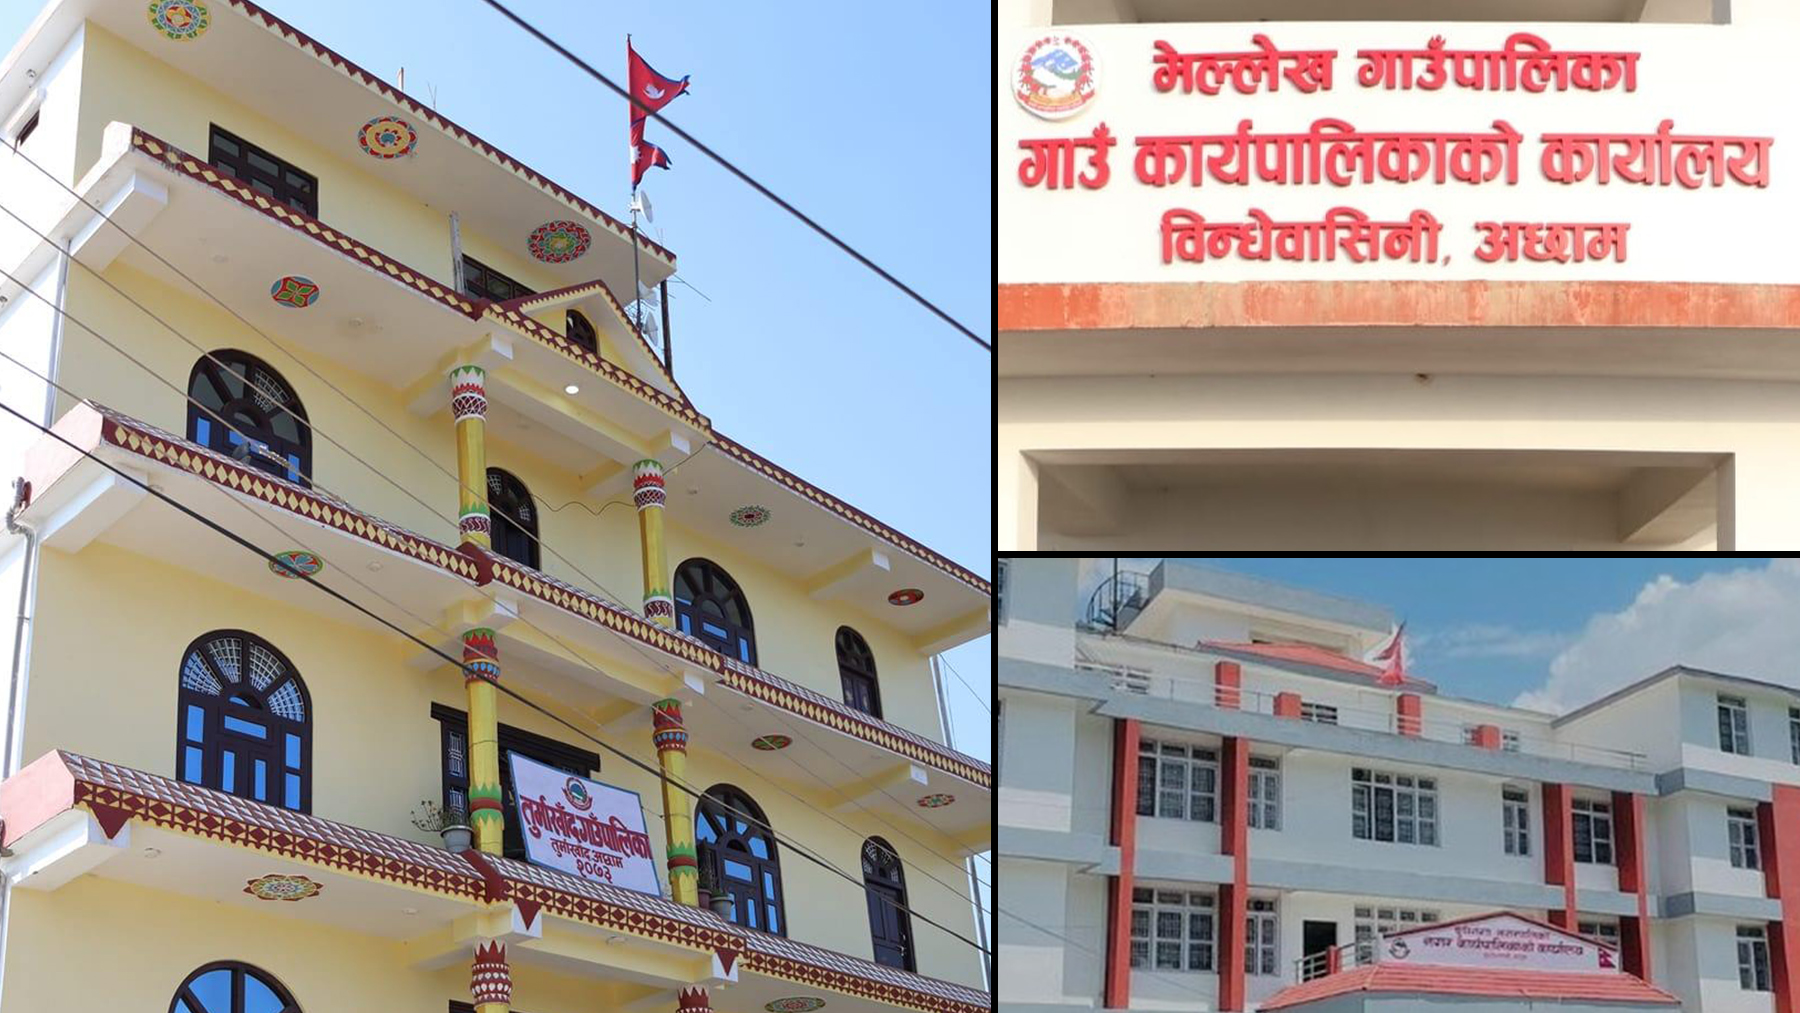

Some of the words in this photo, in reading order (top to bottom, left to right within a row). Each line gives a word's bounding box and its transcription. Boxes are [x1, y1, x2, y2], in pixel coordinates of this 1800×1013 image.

[1152, 33, 1338, 95] मेल्लेख
[1357, 34, 1640, 93] गाउँपालिका
[1017, 122, 1117, 189] गाउँ
[1132, 117, 1523, 187] कार्यपालिकाको
[1540, 118, 1774, 189] कार्यालय
[1473, 221, 1631, 264] अछाम
[576, 858, 613, 884] २०७३
